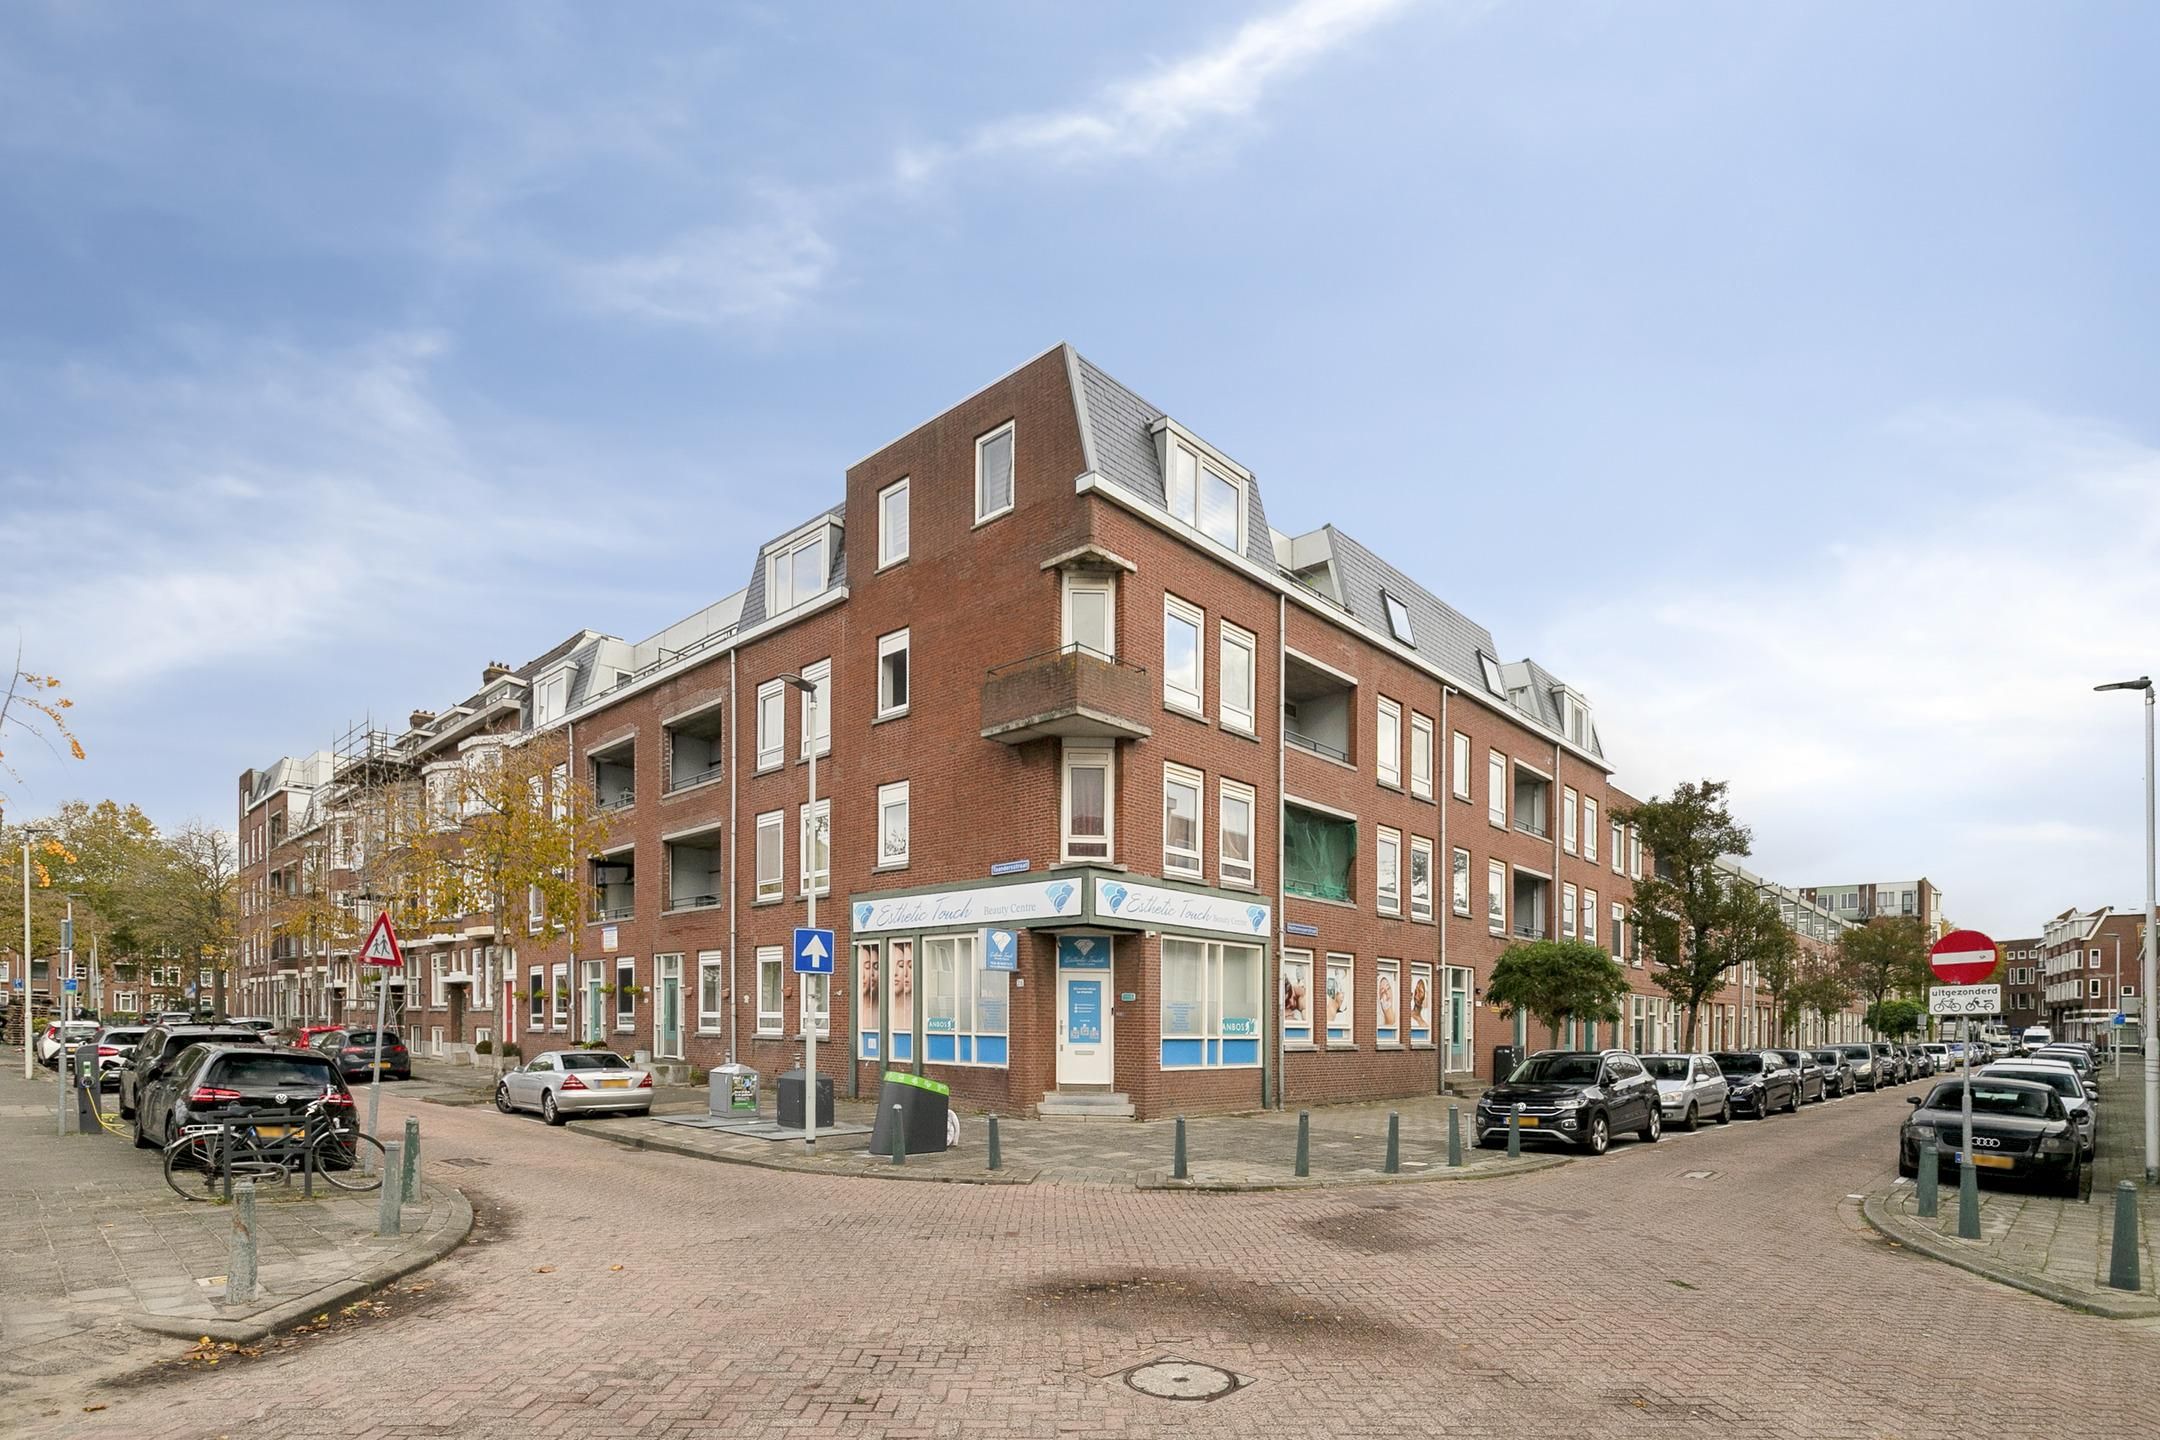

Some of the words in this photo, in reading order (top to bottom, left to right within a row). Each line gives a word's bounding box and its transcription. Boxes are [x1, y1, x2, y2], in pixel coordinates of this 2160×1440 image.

[877, 902, 926, 927] Esthetic
[932, 896, 973, 921] Touch
[984, 904, 1009, 916] Beauty
[1010, 903, 1036, 913] Centre
[1126, 892, 1176, 916] Esthetic
[1180, 899, 1213, 922] Touch
[1932, 987, 1998, 998] uitgezonderd
[1222, 1023, 1244, 1031] ANBOS
